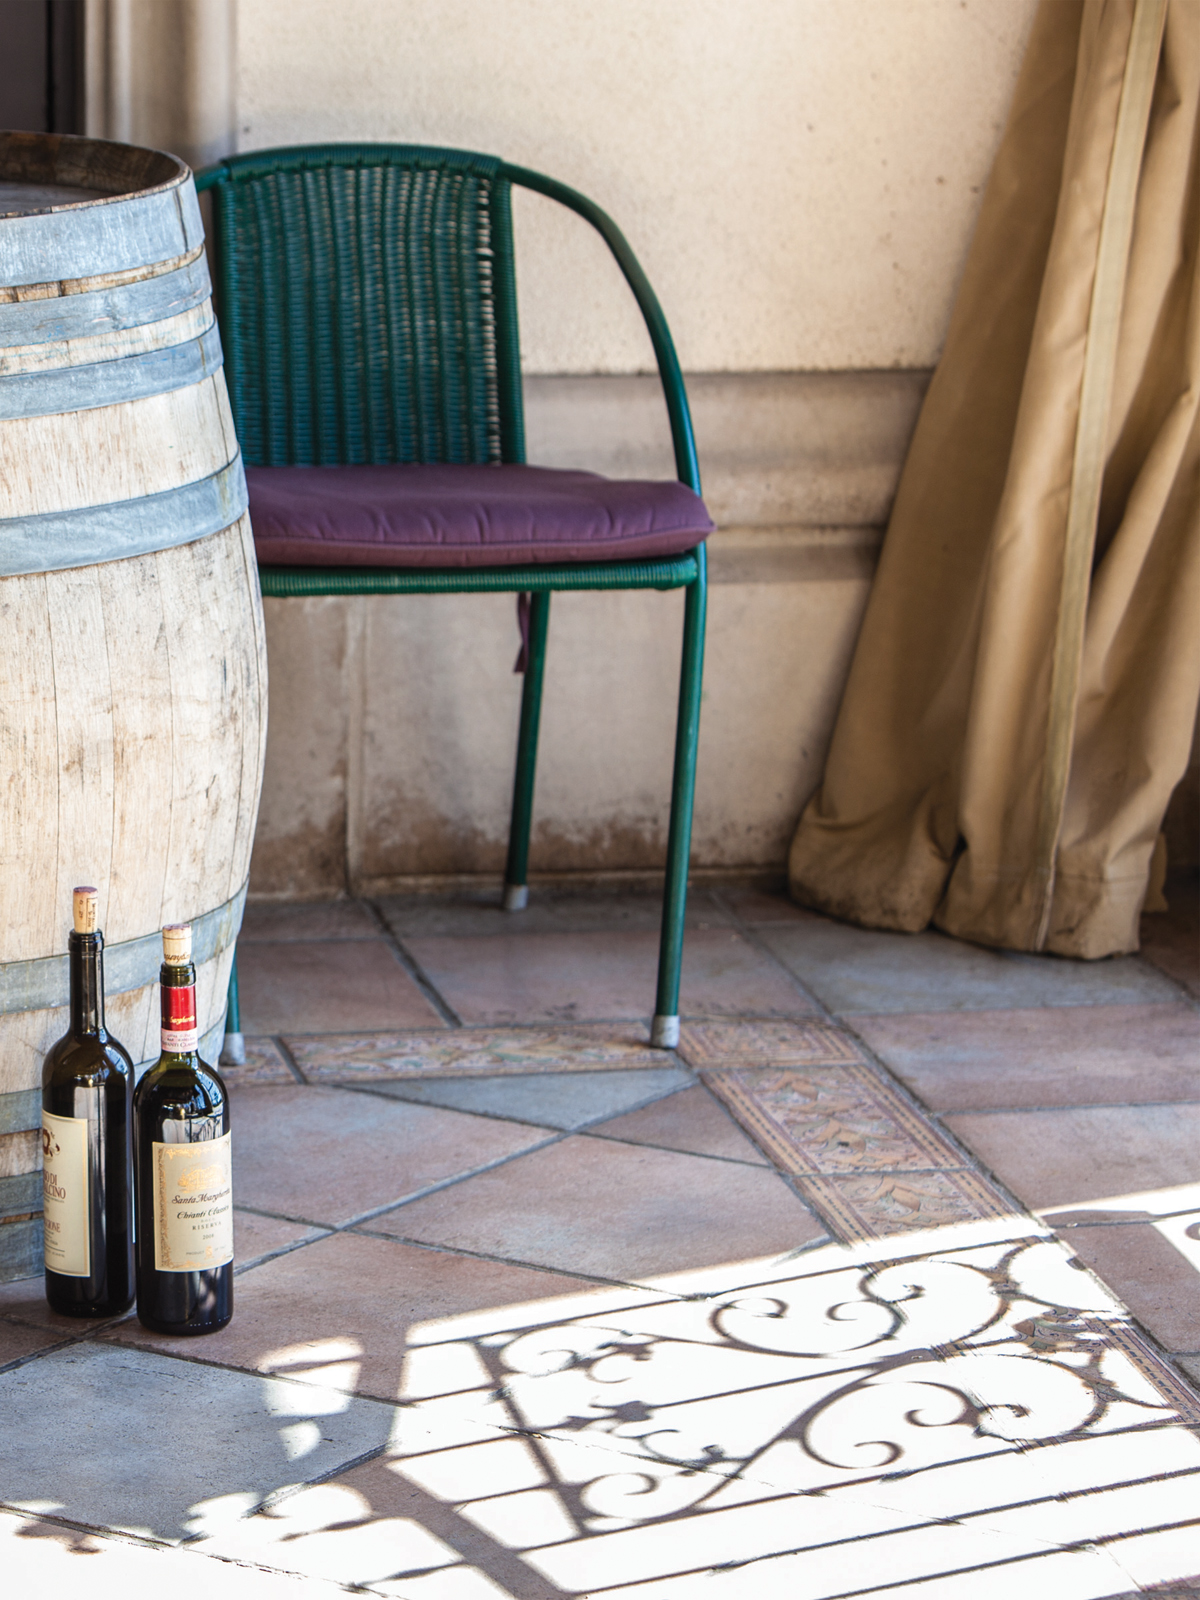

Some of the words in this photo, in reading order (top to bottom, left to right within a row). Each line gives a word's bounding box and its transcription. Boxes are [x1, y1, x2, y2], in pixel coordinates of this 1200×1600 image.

[49, 1172, 58, 1186] DI
[171, 1194, 196, 1205] Santa
[176, 1210, 206, 1219] Chianti
[191, 1221, 222, 1231] RISERVA
